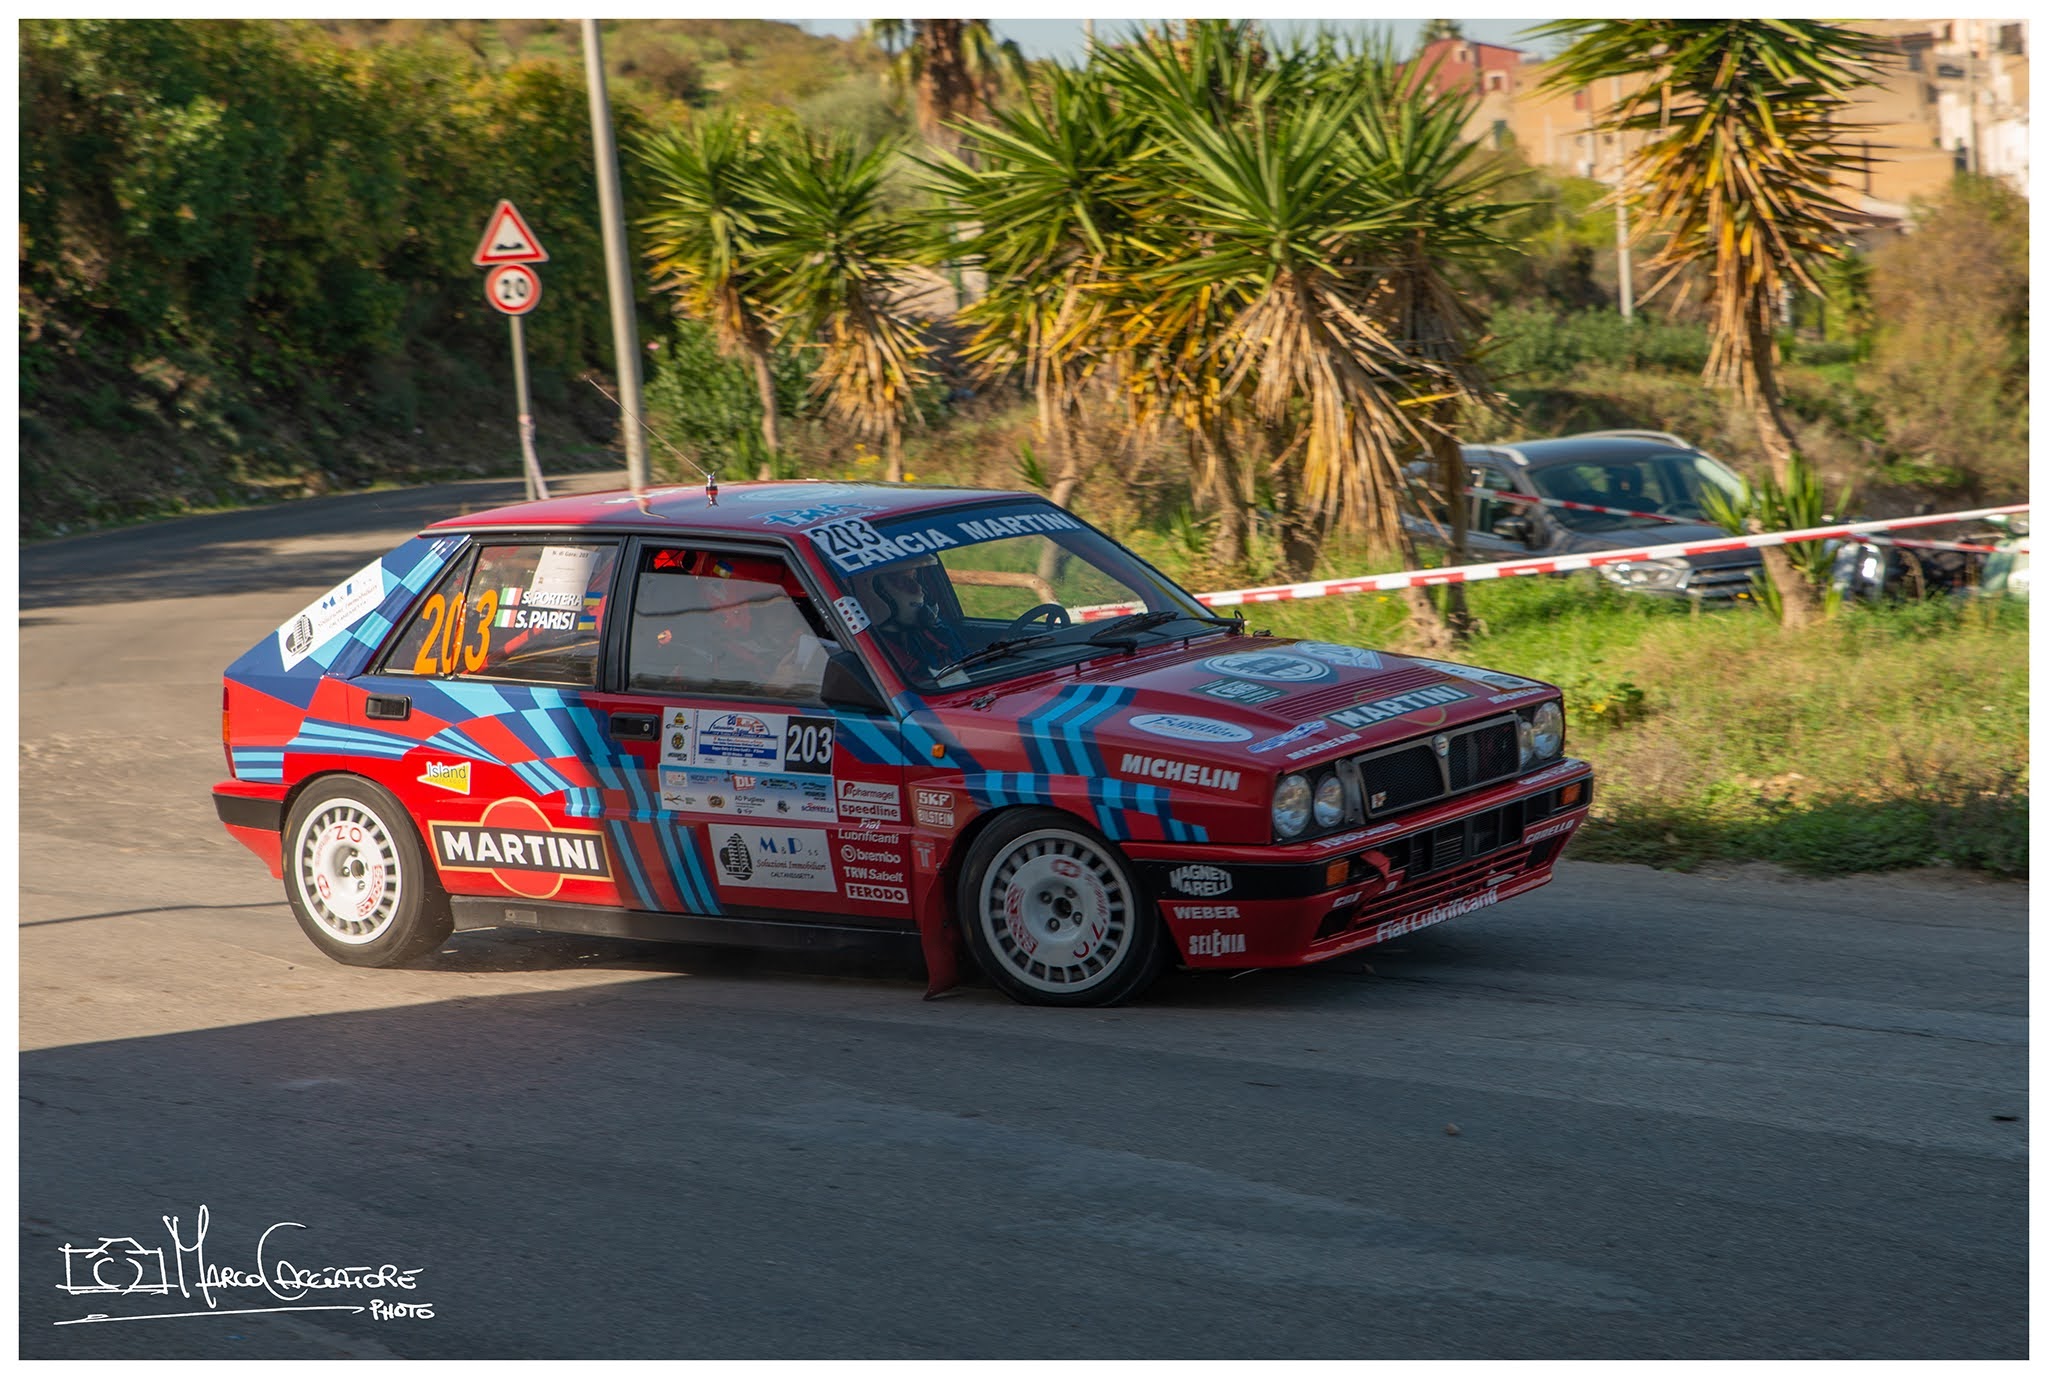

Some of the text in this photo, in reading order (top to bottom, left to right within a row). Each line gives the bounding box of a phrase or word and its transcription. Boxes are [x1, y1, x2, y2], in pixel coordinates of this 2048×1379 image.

[502, 277, 528, 299] 20
[813, 519, 877, 556] 203
[835, 513, 1082, 573] LANCIA MARTINI
[521, 591, 584, 606] S.PORTERA
[515, 610, 576, 630] S.PARISI
[415, 588, 498, 675] 203
[1329, 684, 1470, 728] MARTINI
[786, 725, 833, 765] 203
[1286, 732, 1362, 760] MICHELIN
[428, 763, 467, 778] Island
[1120, 754, 1241, 791] MICHELIN
[735, 775, 757, 788] DLF
[852, 786, 894, 800] pharmagel
[918, 792, 950, 806] SKF
[842, 803, 898, 817] speedline
[918, 809, 953, 826] BILSTEIN
[859, 819, 881, 829] Fiat
[838, 828, 900, 844] Lubrificanti
[441, 831, 600, 870] MARTINI
[759, 836, 778, 854] M
[856, 848, 901, 863] brembo
[843, 866, 904, 882] TRW Sabelt
[848, 885, 905, 901] FERODO
[1173, 906, 1240, 919] WEBER
[1375, 917, 1410, 943] Fiat
[1410, 885, 1500, 931] Lubrificanti
